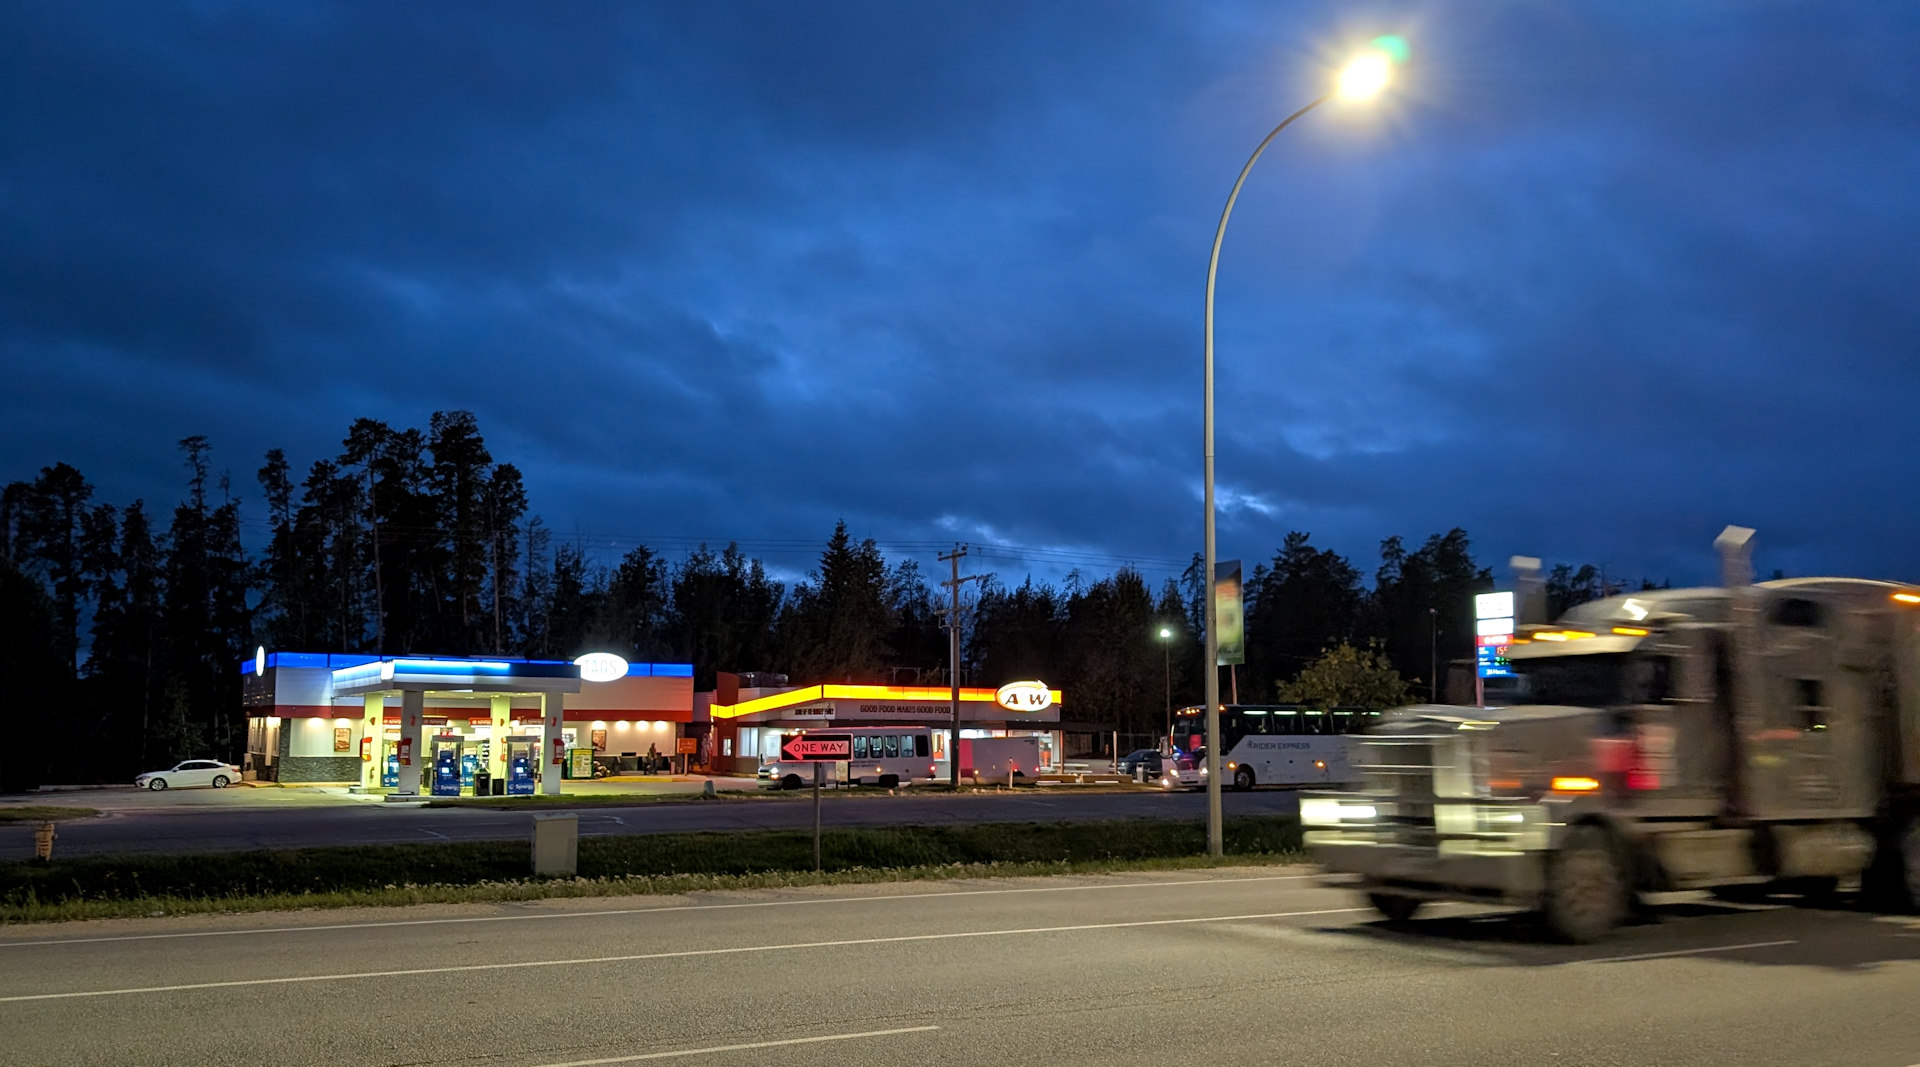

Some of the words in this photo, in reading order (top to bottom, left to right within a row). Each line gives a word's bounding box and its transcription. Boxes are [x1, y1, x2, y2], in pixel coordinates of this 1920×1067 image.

[584, 659, 617, 675] TAGS
[1005, 693, 1047, 705] AW
[860, 705, 878, 713] GOOD
[879, 705, 896, 713] FOOD
[897, 705, 916, 713] MAKES
[917, 705, 934, 713] GOOD
[935, 705, 950, 713] FOOD
[794, 743, 817, 752] ONE
[819, 743, 844, 752] WAY
[1253, 742, 1276, 750] RIDER
[1278, 742, 1310, 750] EXPRESS
